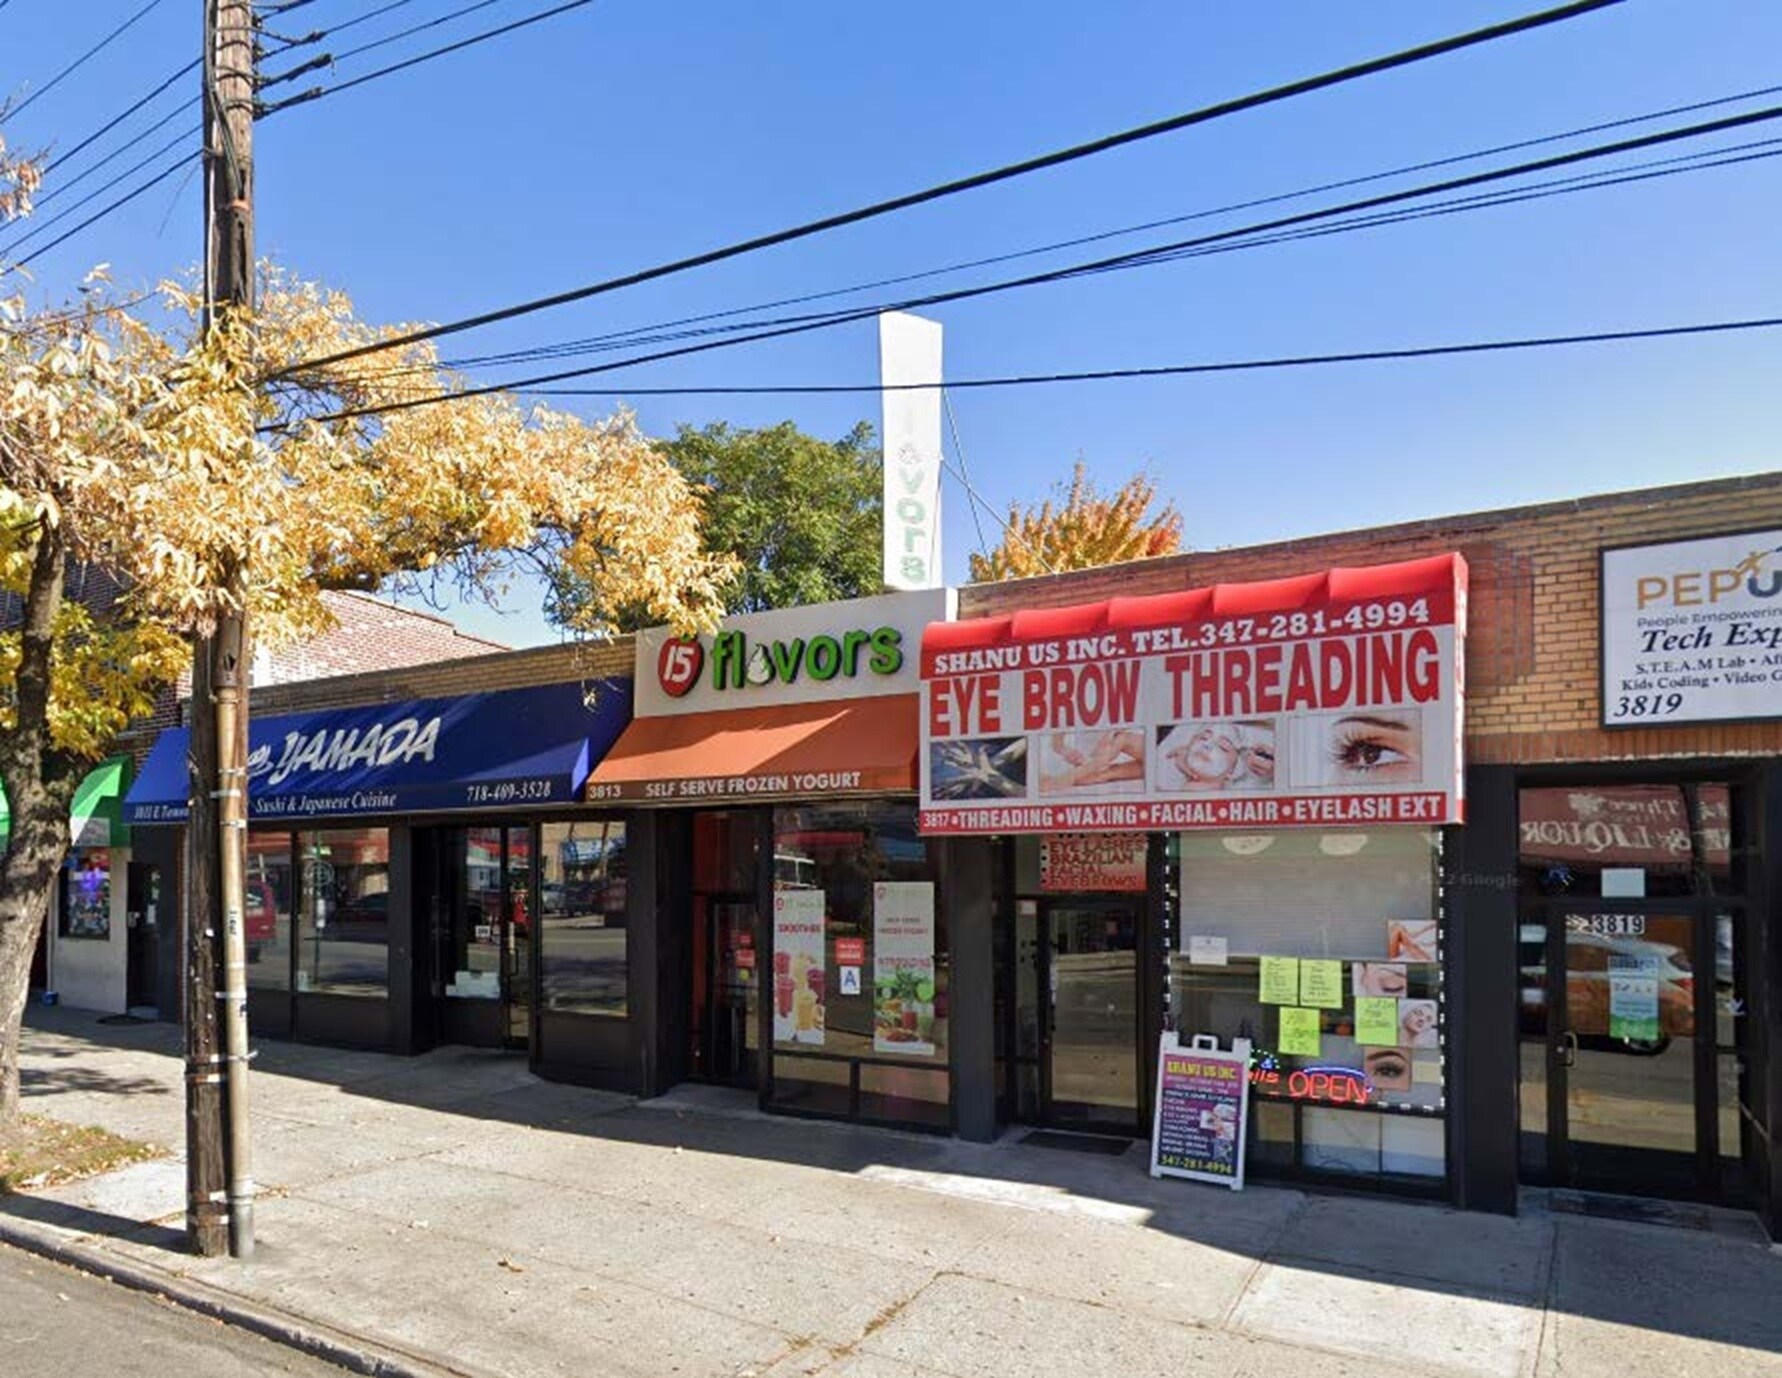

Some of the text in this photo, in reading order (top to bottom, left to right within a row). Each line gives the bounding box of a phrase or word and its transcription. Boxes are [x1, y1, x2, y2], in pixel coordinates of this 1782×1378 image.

[1637, 608, 1782, 628] People Empowerin
[1641, 622, 1782, 653] Tech Exp
[662, 644, 695, 683] 15
[934, 645, 1021, 674] SHANU
[1028, 642, 1060, 664] US
[1066, 636, 1125, 661] INC.
[1636, 658, 1713, 674] S.T.E.A.M
[1718, 656, 1745, 669] Lab
[929, 628, 1440, 737] EYE BROW THREADING
[1622, 679, 1653, 691] Kids
[1657, 675, 1709, 689] Coding
[1724, 672, 1767, 685] Video
[1614, 693, 1683, 717] 3819
[268, 717, 441, 785] YAMADA
[589, 772, 861, 798] 3813 SELF SERVE FROZEN YOGURT
[255, 792, 397, 814] Sushi & Japanese Cuisine
[957, 809, 1053, 828] THREADING
[1066, 805, 1137, 824] WAXING
[1150, 802, 1216, 823] FACIAL
[1229, 801, 1278, 821] HAIR
[1295, 797, 1392, 820] EYELASH
[1399, 796, 1441, 817] EXT
[1593, 914, 1643, 933] 3819
[844, 970, 857, 987] A
[1289, 1070, 1368, 1104] OPEN
